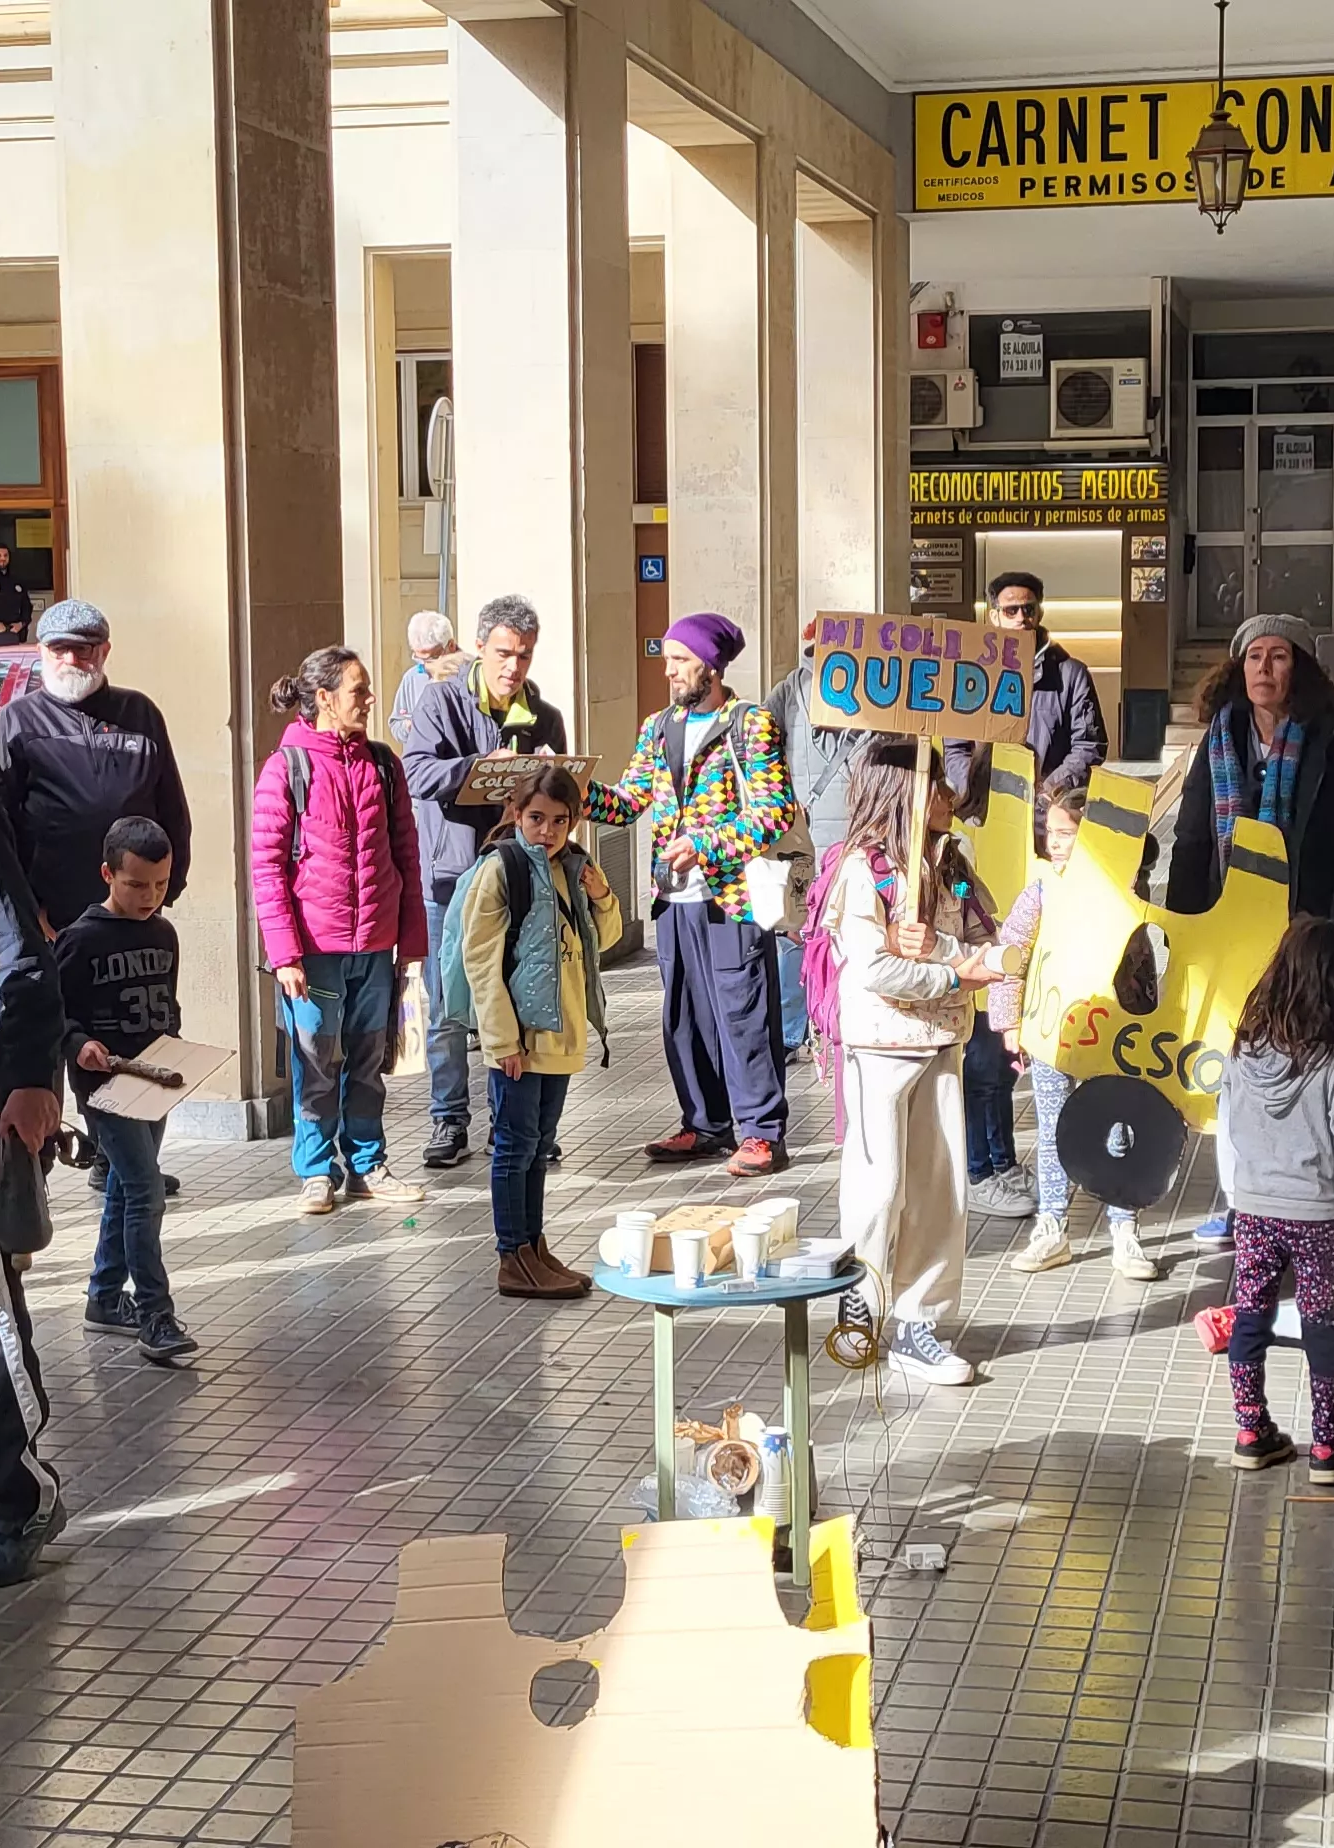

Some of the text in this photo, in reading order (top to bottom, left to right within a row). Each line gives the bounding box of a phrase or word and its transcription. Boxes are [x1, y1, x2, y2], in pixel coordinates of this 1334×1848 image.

[941, 92, 1168, 169] CARNET
[923, 175, 1000, 188] CERTIFICADOS
[1247, 166, 1286, 190] DE
[937, 191, 985, 203] MEDICOS
[1002, 341, 1042, 355] SE ALQUILA
[1002, 359, 1014, 371] 974
[910, 468, 1160, 502] RECONOCIMIENTOS MEDICOS
[958, 506, 973, 525] de
[976, 506, 1030, 525] conducir
[1033, 509, 1041, 527] y
[1045, 506, 1103, 526] permisos
[1107, 505, 1122, 523] de
[1126, 507, 1166, 523] armas
[820, 617, 866, 649] MI
[977, 631, 1022, 669] SE
[819, 650, 1026, 717] QUEDA
[120, 984, 171, 1035] 35
